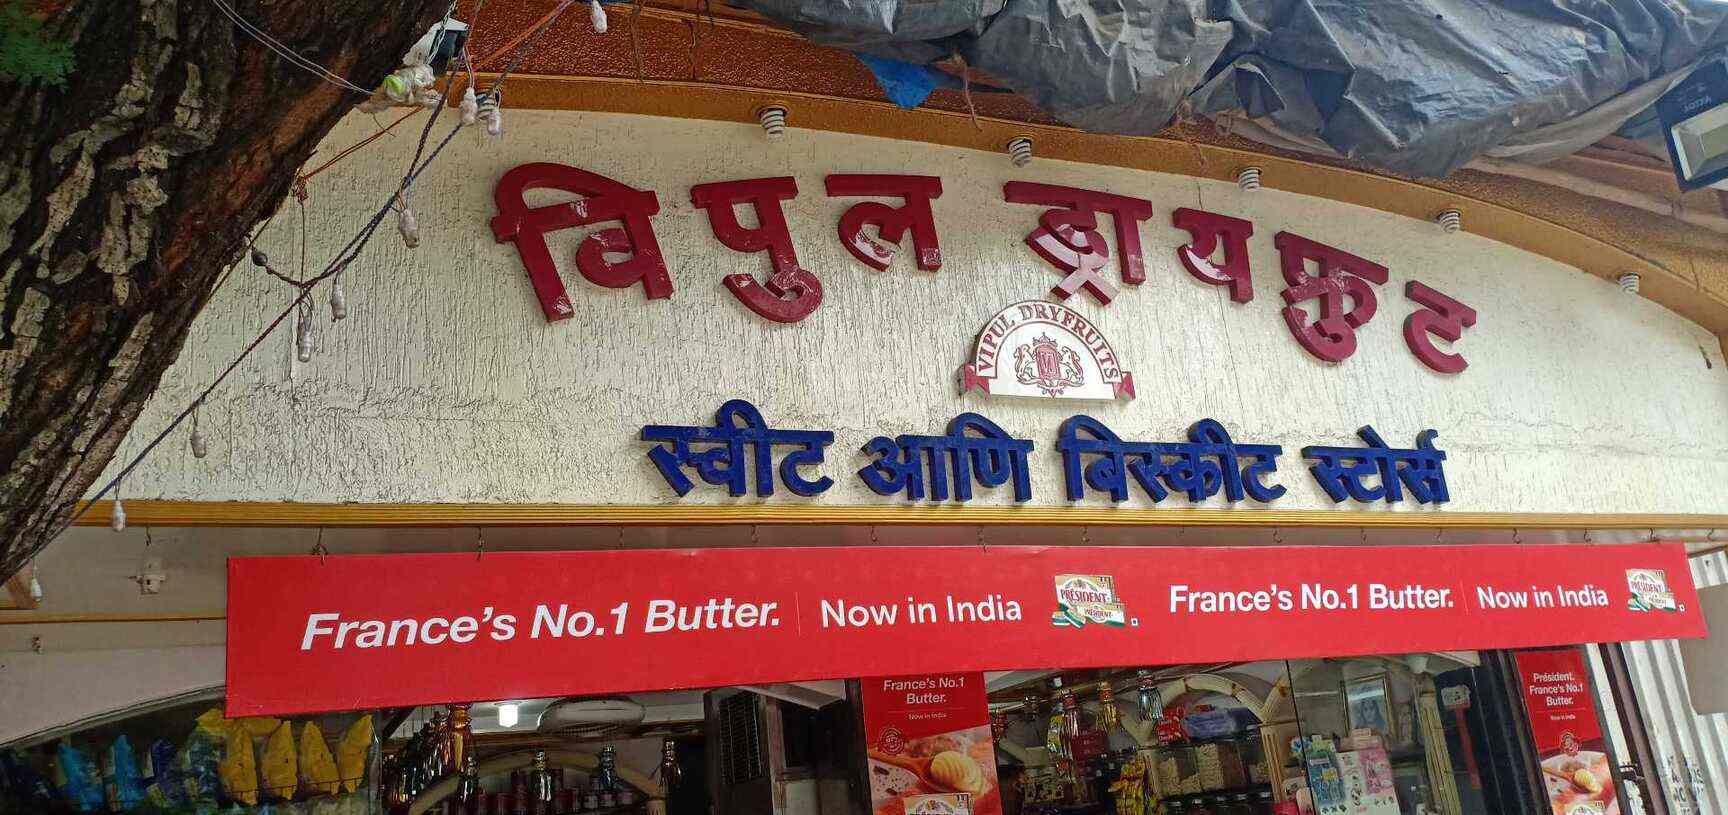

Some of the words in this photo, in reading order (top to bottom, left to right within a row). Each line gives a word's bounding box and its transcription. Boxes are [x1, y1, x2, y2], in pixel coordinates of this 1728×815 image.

[490, 162, 943, 323] विपुल
[978, 314, 1016, 373] VIPUL
[1017, 302, 1119, 380] DRYFRUITS
[641, 399, 835, 497] स्वीट
[857, 412, 1034, 502] आणि
[1055, 414, 1288, 504] बिस्कीट
[1301, 424, 1450, 504] स्टोर्स
[820, 599, 898, 628] Now
[907, 596, 937, 624] in
[946, 594, 1023, 622] India
[1169, 583, 1294, 613] France's
[1301, 583, 1358, 610] No.1
[1369, 583, 1455, 609] Butter.
[1476, 585, 1529, 609] Now
[1532, 586, 1554, 608] in
[1557, 584, 1610, 608] India
[301, 606, 516, 650] France's
[530, 602, 629, 639] No.1
[645, 598, 780, 633] Butter.
[883, 678, 936, 691] France's
[939, 677, 965, 688] No.1
[906, 693, 947, 704] Butter.
[1529, 684, 1565, 695] France's
[1566, 683, 1584, 693] No.1
[1546, 696, 1574, 706] Butter.
